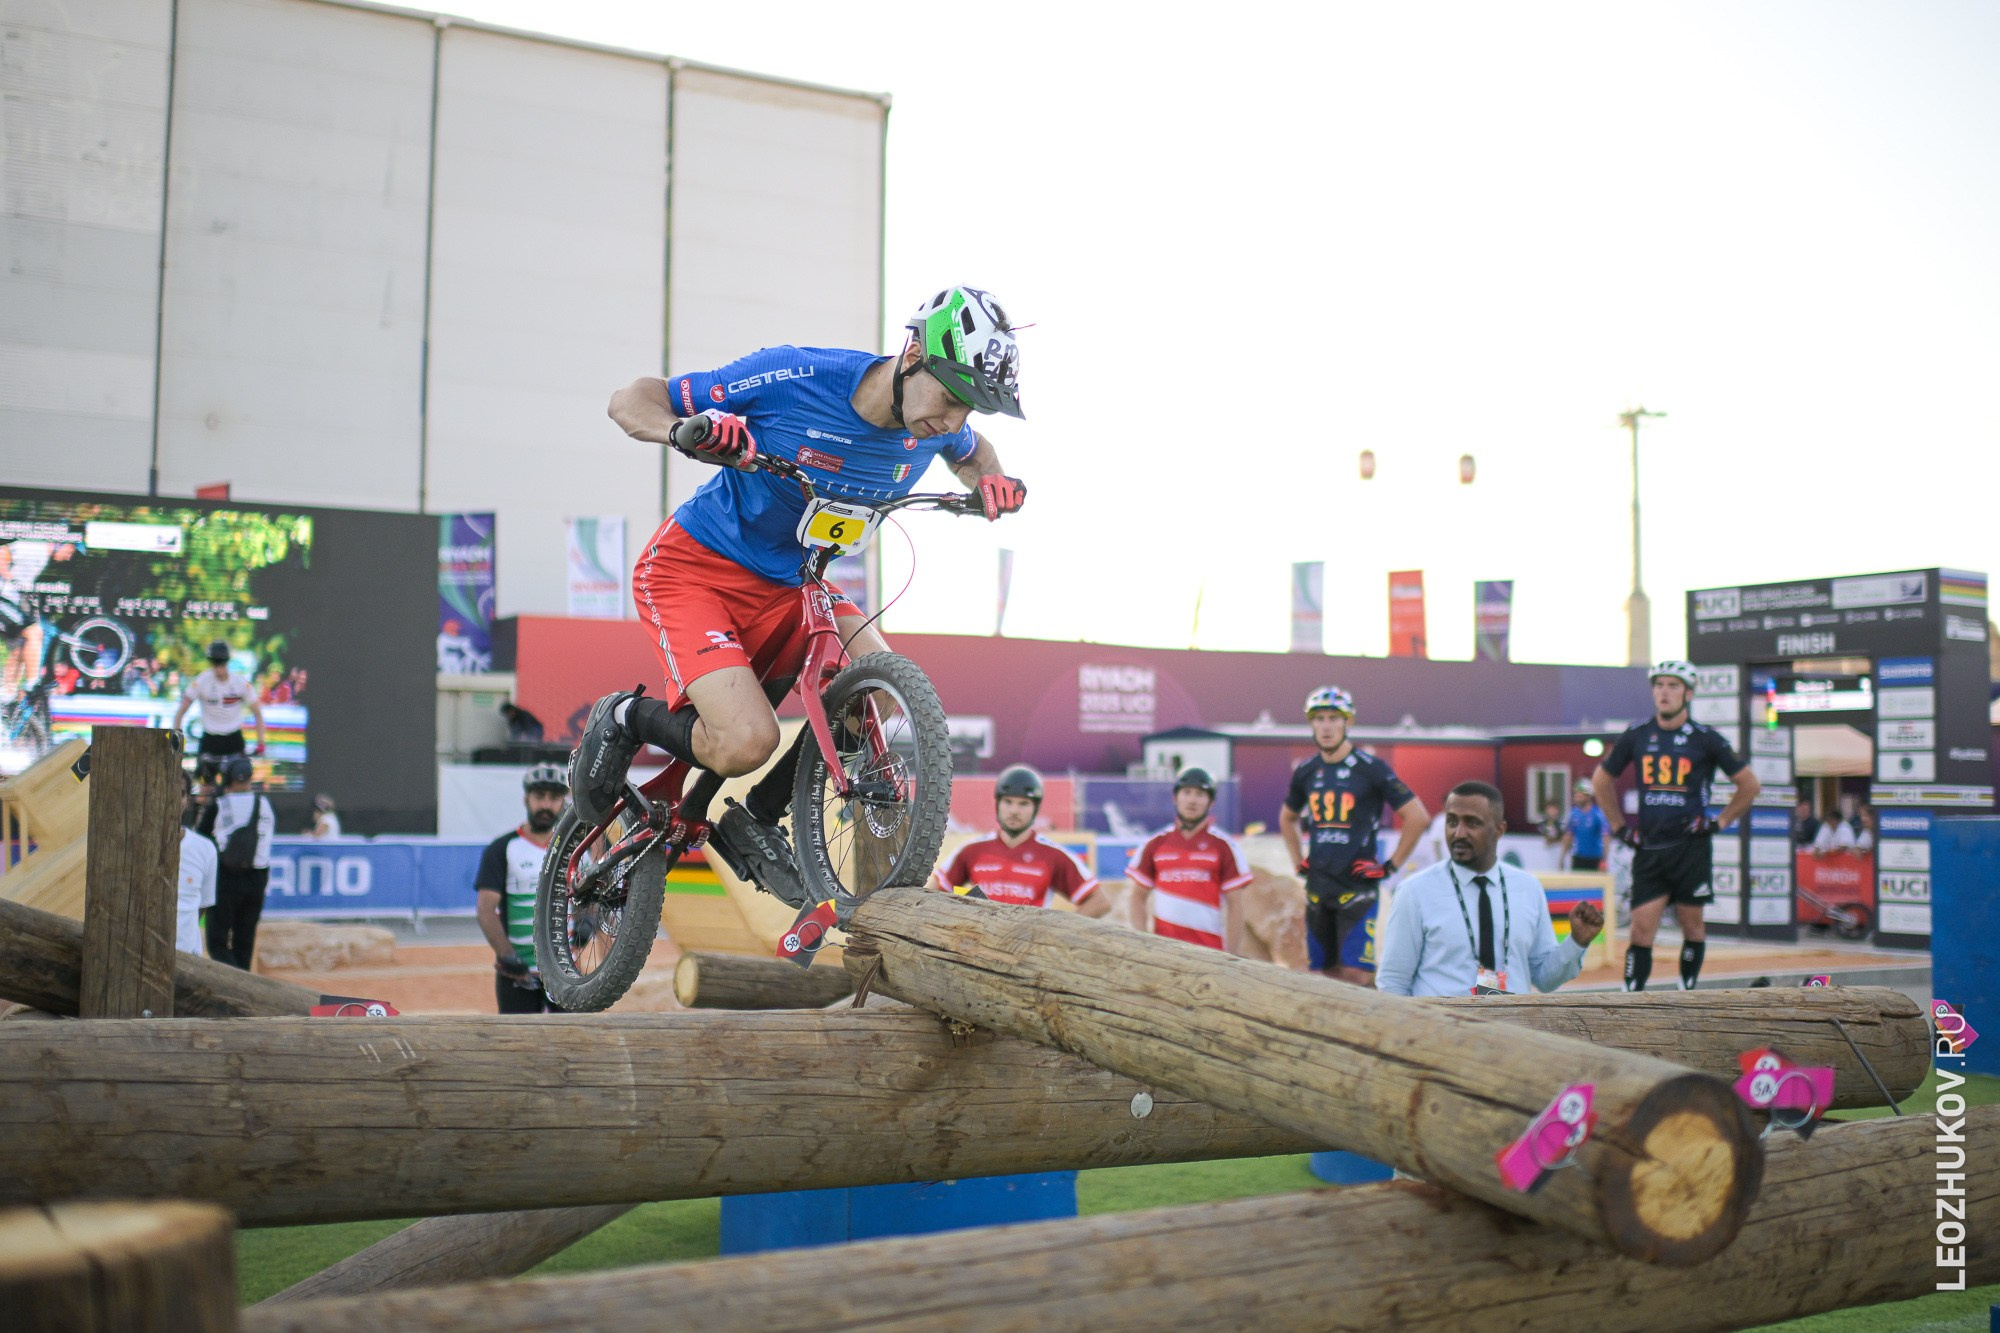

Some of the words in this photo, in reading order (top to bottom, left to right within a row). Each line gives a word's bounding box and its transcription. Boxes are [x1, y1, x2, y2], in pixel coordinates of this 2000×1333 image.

[728, 366, 815, 394] CASTELLI
[813, 478, 894, 500] ITALIA
[829, 521, 845, 539] 6
[1702, 596, 1735, 613] UCI
[1778, 633, 1835, 656] FINISH
[1642, 754, 1692, 785] ESP
[1309, 790, 1355, 822] ESP
[1159, 869, 1212, 883] AUSTRIA
[1889, 879, 1929, 897] UCI
